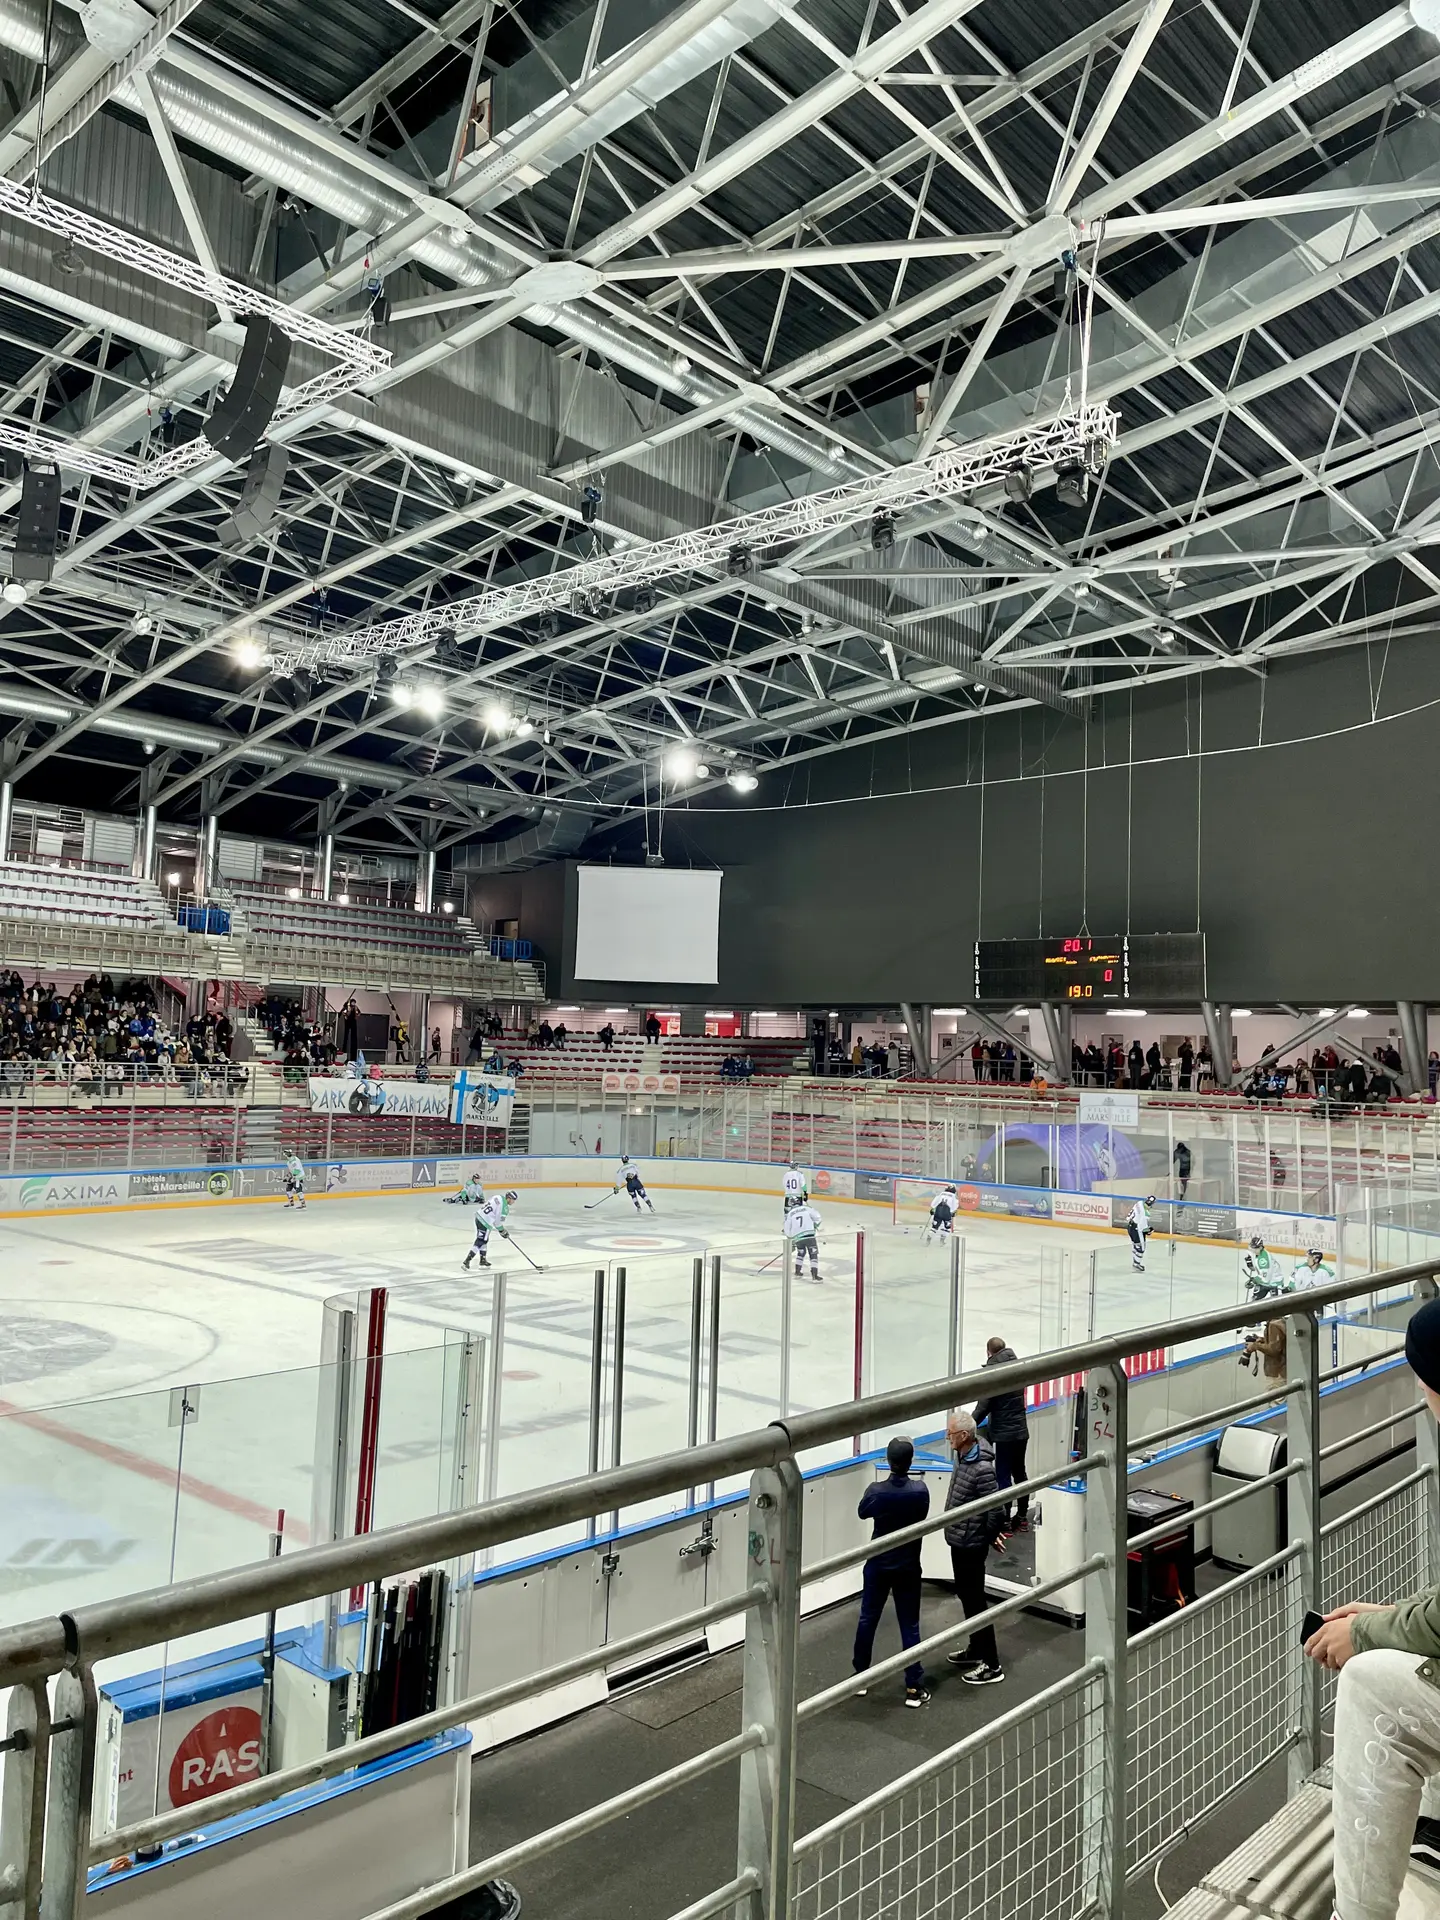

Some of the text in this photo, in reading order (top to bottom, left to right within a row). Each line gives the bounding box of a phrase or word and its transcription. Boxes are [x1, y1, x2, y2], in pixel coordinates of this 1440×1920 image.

[1104, 969, 1113, 982] 0
[311, 1090, 448, 1115] DARK SPARTANS
[142, 1174, 166, 1183] hôtels
[210, 1180, 228, 1189] B&B
[45, 1184, 119, 1201] AXIMA
[960, 1191, 978, 1199] radio
[1055, 1200, 1109, 1214] STATIONDJ
[795, 1215, 803, 1228] 7
[1090, 1397, 1099, 1411] 3
